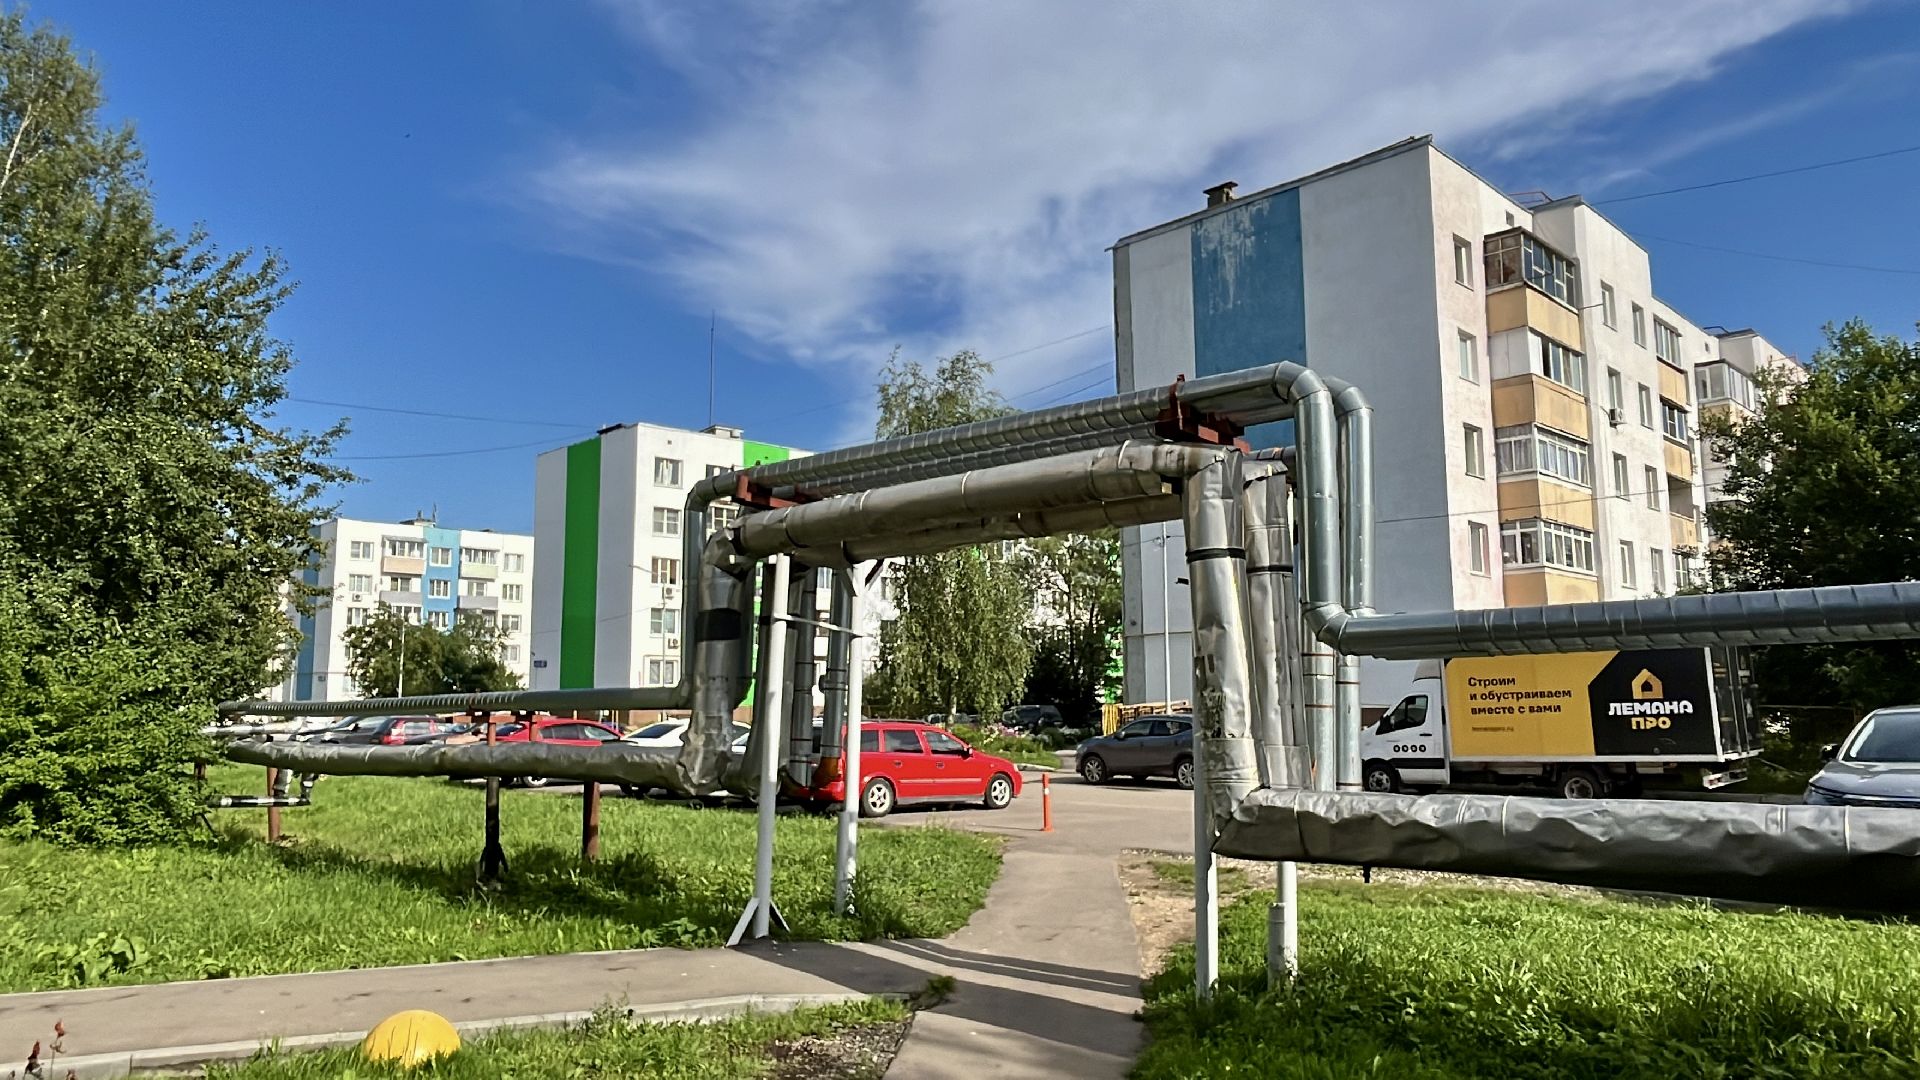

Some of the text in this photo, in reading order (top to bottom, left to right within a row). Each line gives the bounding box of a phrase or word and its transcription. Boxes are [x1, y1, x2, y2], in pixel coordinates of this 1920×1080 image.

[1468, 677, 1516, 688] Строим
[1469, 690, 1572, 702] и обустраиваем
[1471, 705, 1561, 715] вместе с вами
[1608, 700, 1694, 716] ЛЕМАНА
[1631, 716, 1671, 730] ПРО
